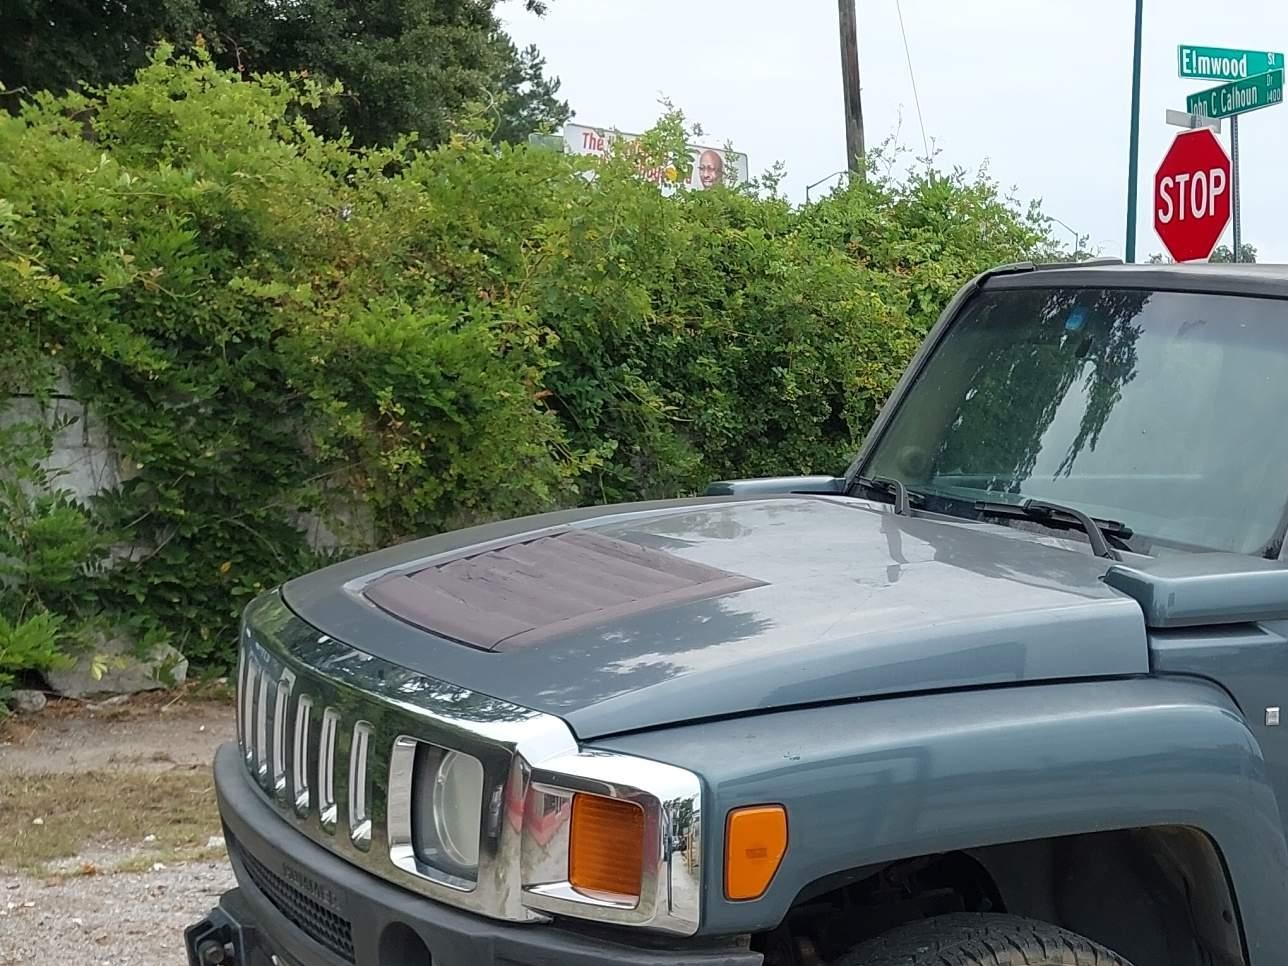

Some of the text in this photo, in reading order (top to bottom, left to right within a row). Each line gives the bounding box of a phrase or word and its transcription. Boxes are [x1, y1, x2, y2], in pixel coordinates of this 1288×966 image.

[1182, 48, 1276, 78] Elmwood St
[1211, 92, 1217, 116] C
[1220, 85, 1258, 114] Calhoun
[1266, 73, 1273, 87] Dr
[582, 132, 605, 152] The
[1158, 167, 1226, 224] STOP
